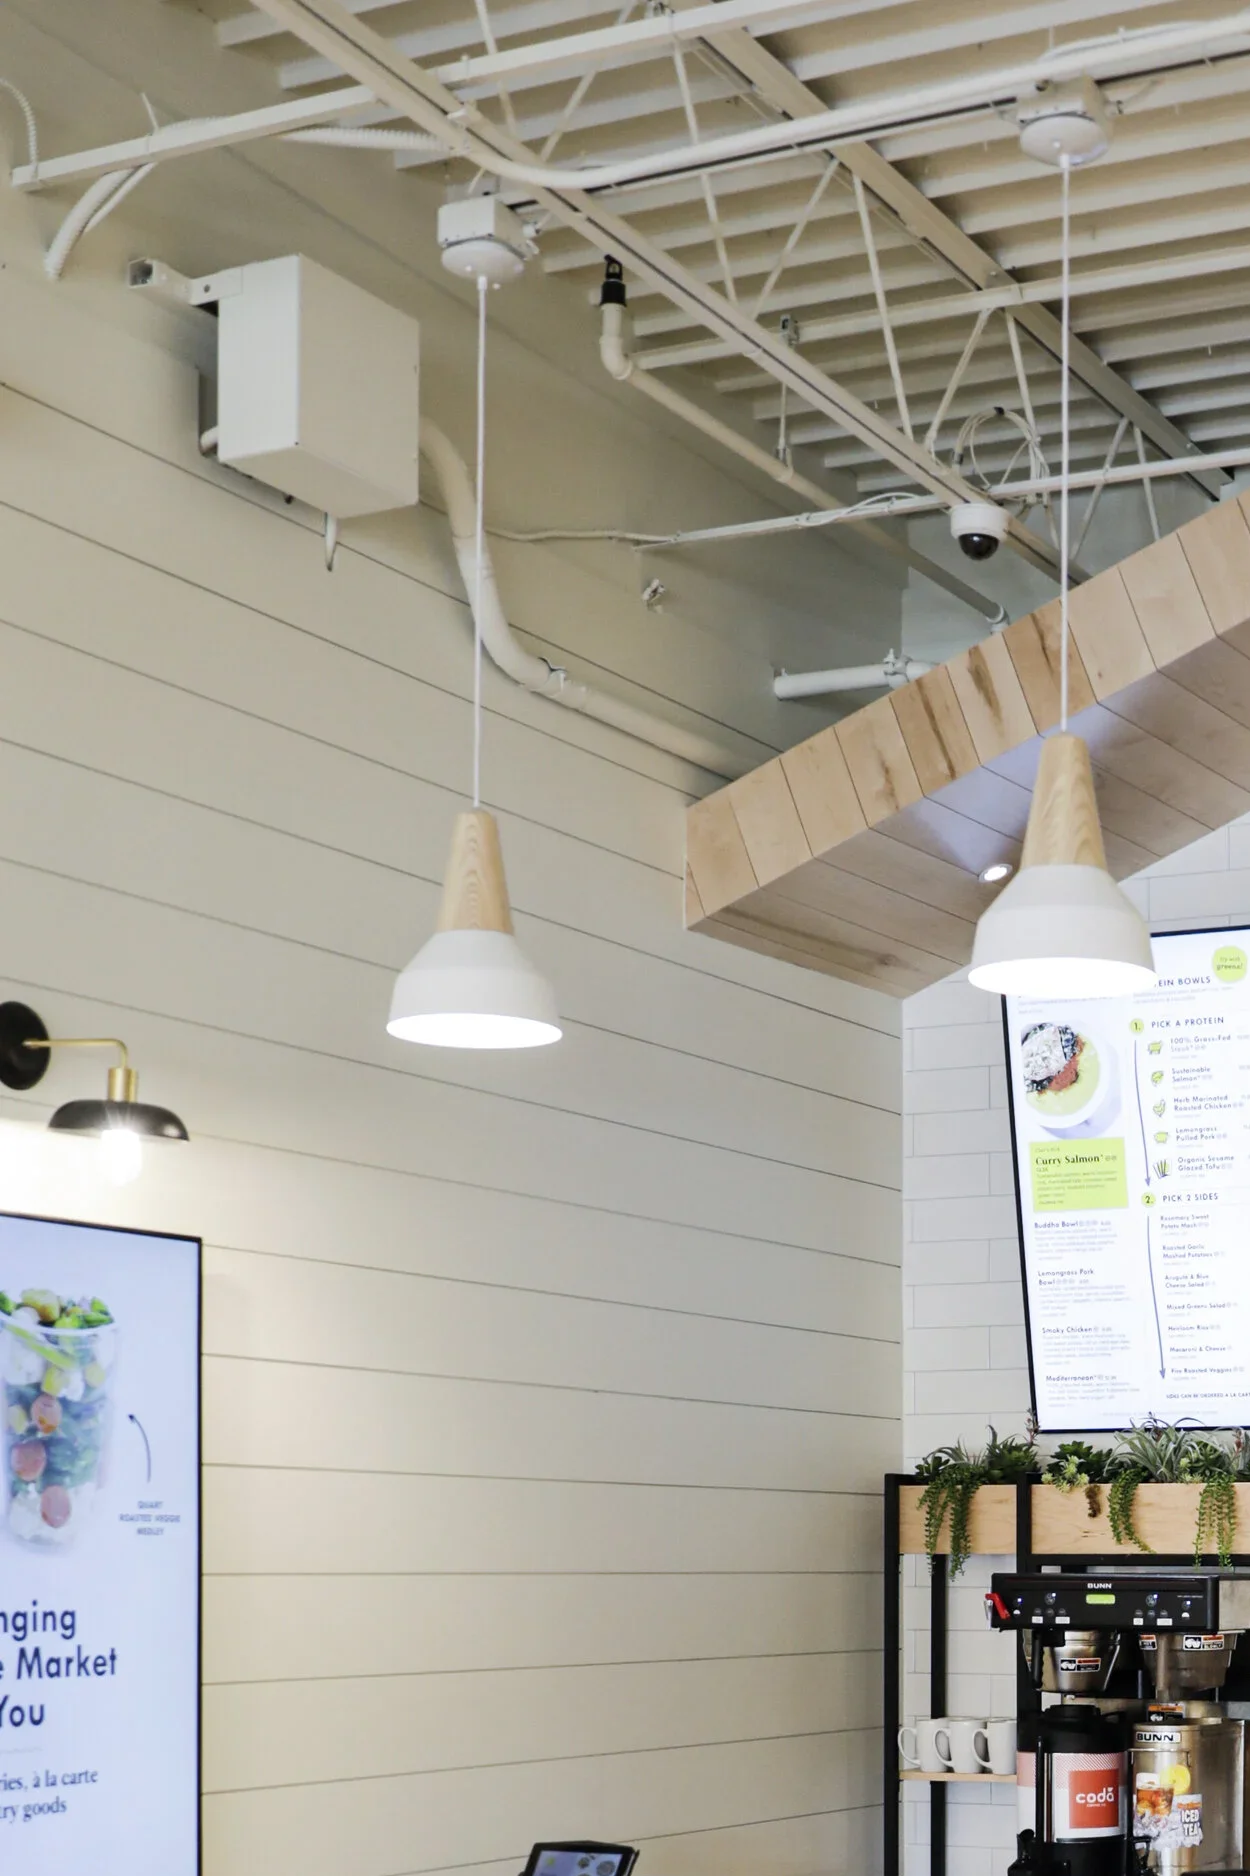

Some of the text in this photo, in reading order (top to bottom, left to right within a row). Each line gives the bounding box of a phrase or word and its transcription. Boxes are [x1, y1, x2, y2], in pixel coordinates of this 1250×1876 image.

[1178, 976, 1211, 986] BOWLS
[1151, 1020, 1171, 1028] PICK
[1175, 1019, 1181, 1027] A
[1184, 1016, 1224, 1026] PROTEIN
[1035, 1157, 1061, 1168] Curry
[1162, 1194, 1183, 1202] PICK
[1194, 1193, 1219, 1201] SIDES
[1042, 1325, 1093, 1335] Smoky Chicken
[15, 1644, 117, 1681] Market
[1136, 1733, 1174, 1741] BUNN
[44, 1769, 58, 1787] la
[60, 1768, 99, 1787] carte
[22, 1796, 68, 1822] goods
[1181, 1809, 1200, 1823] ICED
[1183, 1823, 1199, 1838] TEA
